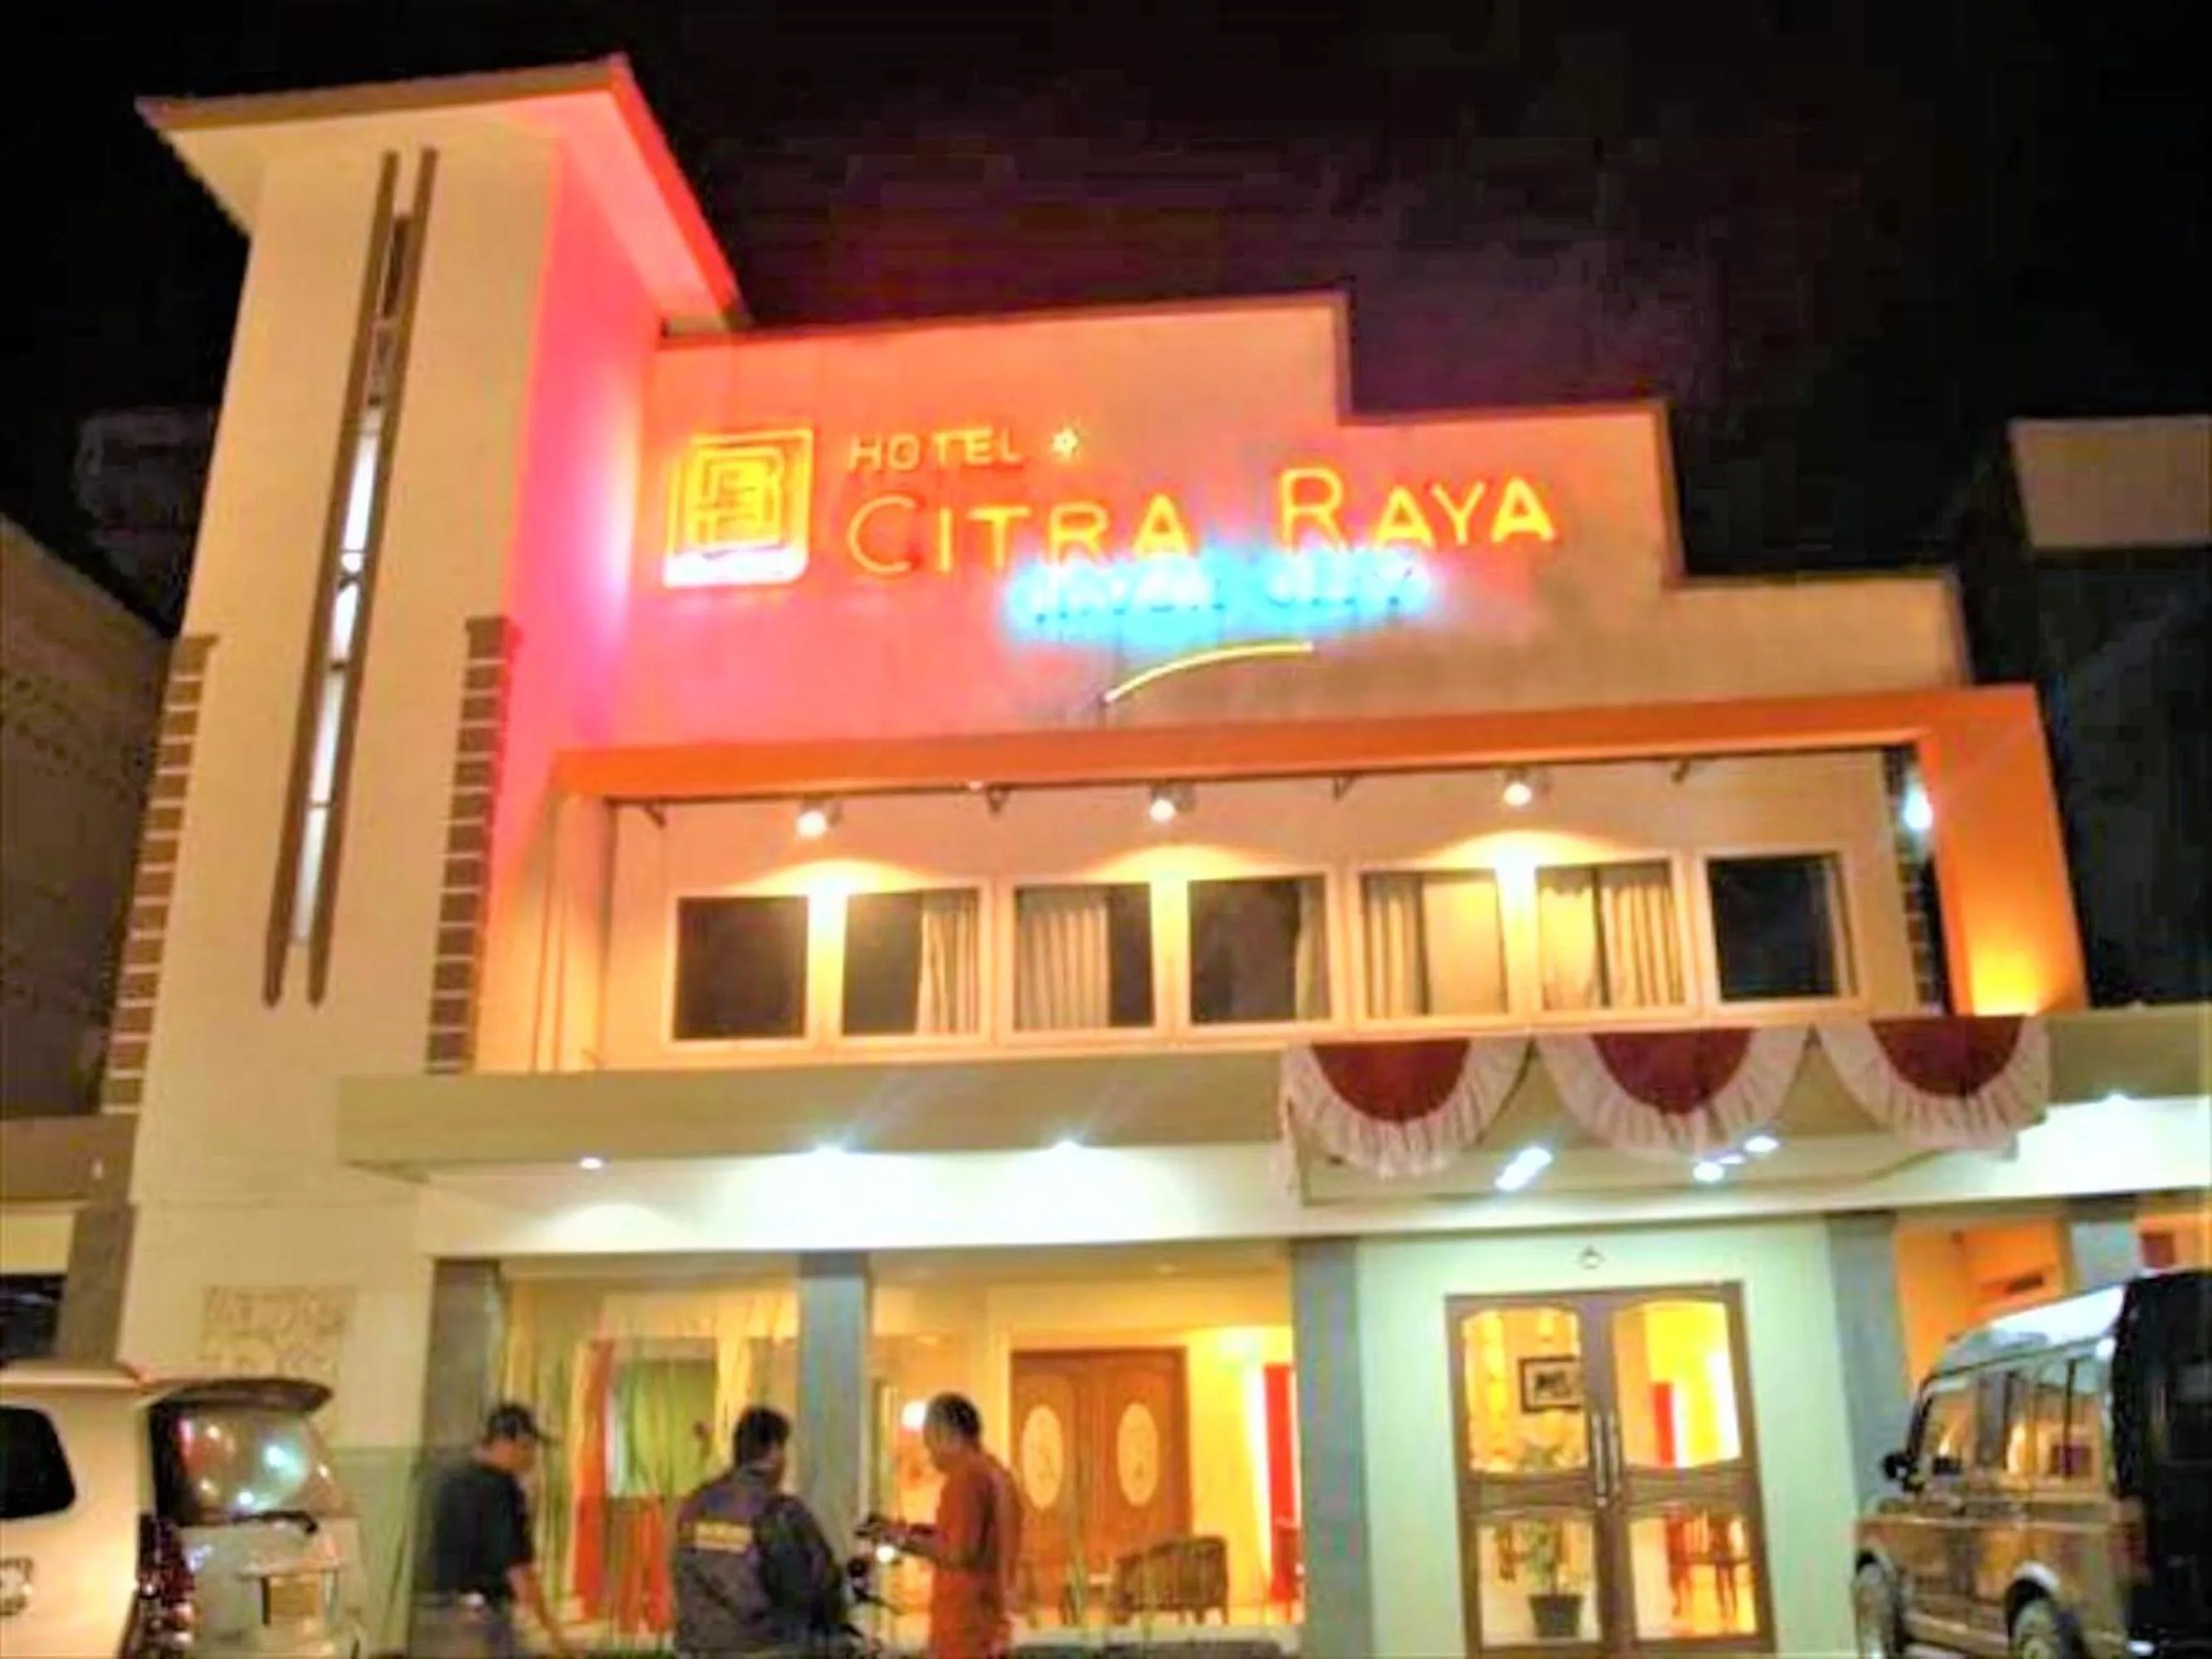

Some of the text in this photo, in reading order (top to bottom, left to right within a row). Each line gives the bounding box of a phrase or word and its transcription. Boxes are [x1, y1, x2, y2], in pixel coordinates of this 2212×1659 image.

[846, 426, 1025, 474] HOTEL
[845, 467, 1557, 575] CITRA RAYA
